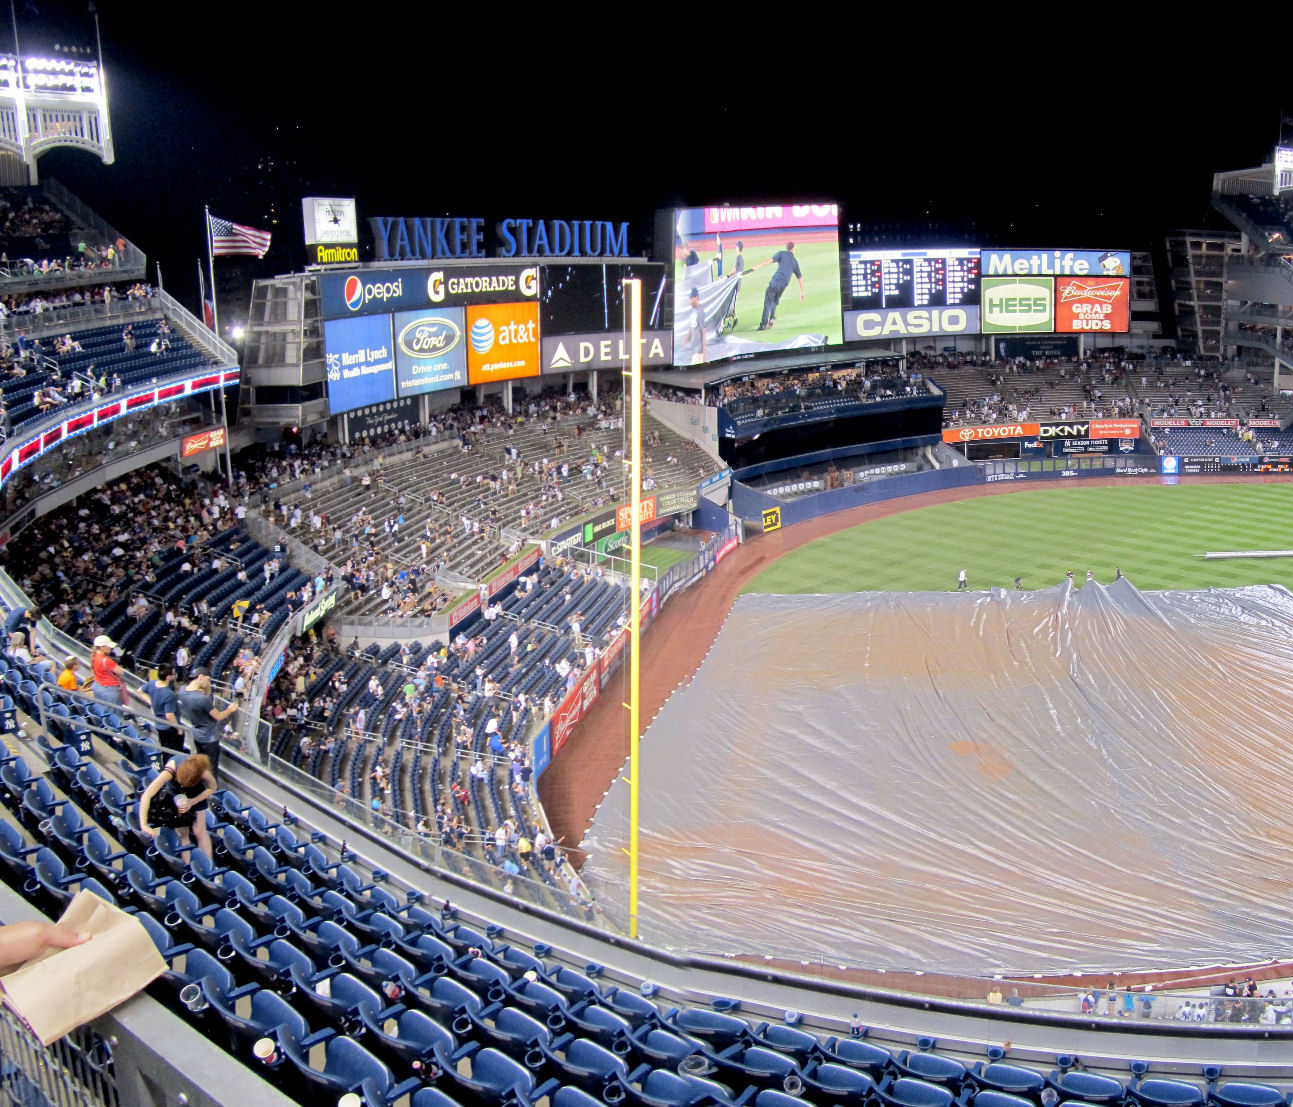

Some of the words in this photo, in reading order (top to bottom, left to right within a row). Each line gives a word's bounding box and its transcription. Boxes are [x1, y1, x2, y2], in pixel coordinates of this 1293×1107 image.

[376, 217, 486, 260] YANKEE
[501, 218, 629, 259] STADIUM
[317, 245, 358, 263] Armitron
[988, 251, 1090, 275] MetLife
[365, 278, 402, 303] pepsi
[448, 275, 516, 294] GATORADE
[1060, 284, 1122, 298] Budweiser
[988, 297, 1047, 313] HESS
[1072, 303, 1112, 314] GRAB
[498, 319, 536, 345] at&t
[856, 309, 967, 337] CASIO
[1072, 320, 1111, 330] BUDS
[412, 326, 447, 351] Ford
[341, 348, 366, 366] Merrill
[367, 346, 388, 365] Lynch
[579, 338, 665, 363] DELA
[412, 363, 432, 375] Drive
[433, 362, 449, 371] one.
[401, 373, 454, 389] tristateford.com
[976, 426, 1024, 438] TOYOTA
[1041, 424, 1089, 437] DKNY
[618, 498, 654, 521] SPTS
[619, 512, 654, 530] AUTRITY
